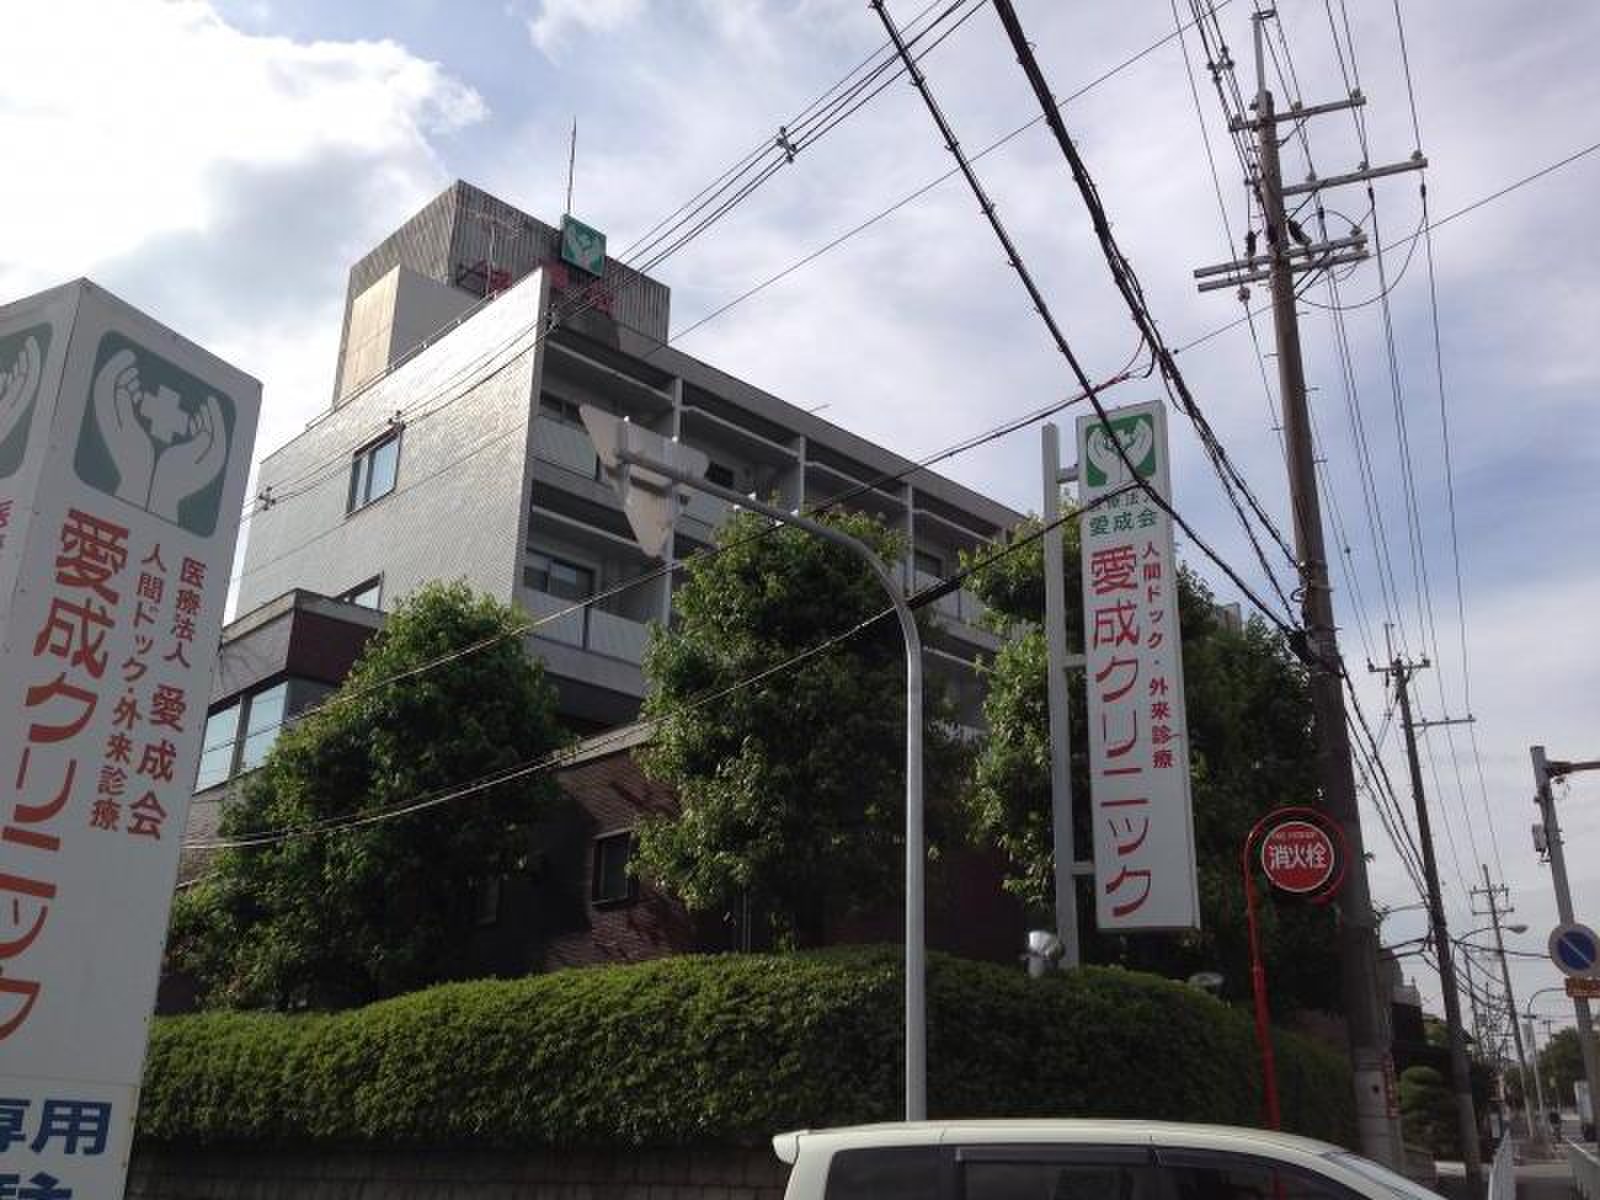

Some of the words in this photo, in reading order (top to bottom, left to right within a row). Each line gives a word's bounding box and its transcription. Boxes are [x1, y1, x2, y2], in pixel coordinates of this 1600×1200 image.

[1089, 508, 1158, 537] 愛成会
[163, 556, 208, 669] 医療法人
[126, 682, 187, 840] 愛成会
[1090, 545, 1151, 917] 愛成クリニック
[1267, 842, 1328, 870] 消火栓
